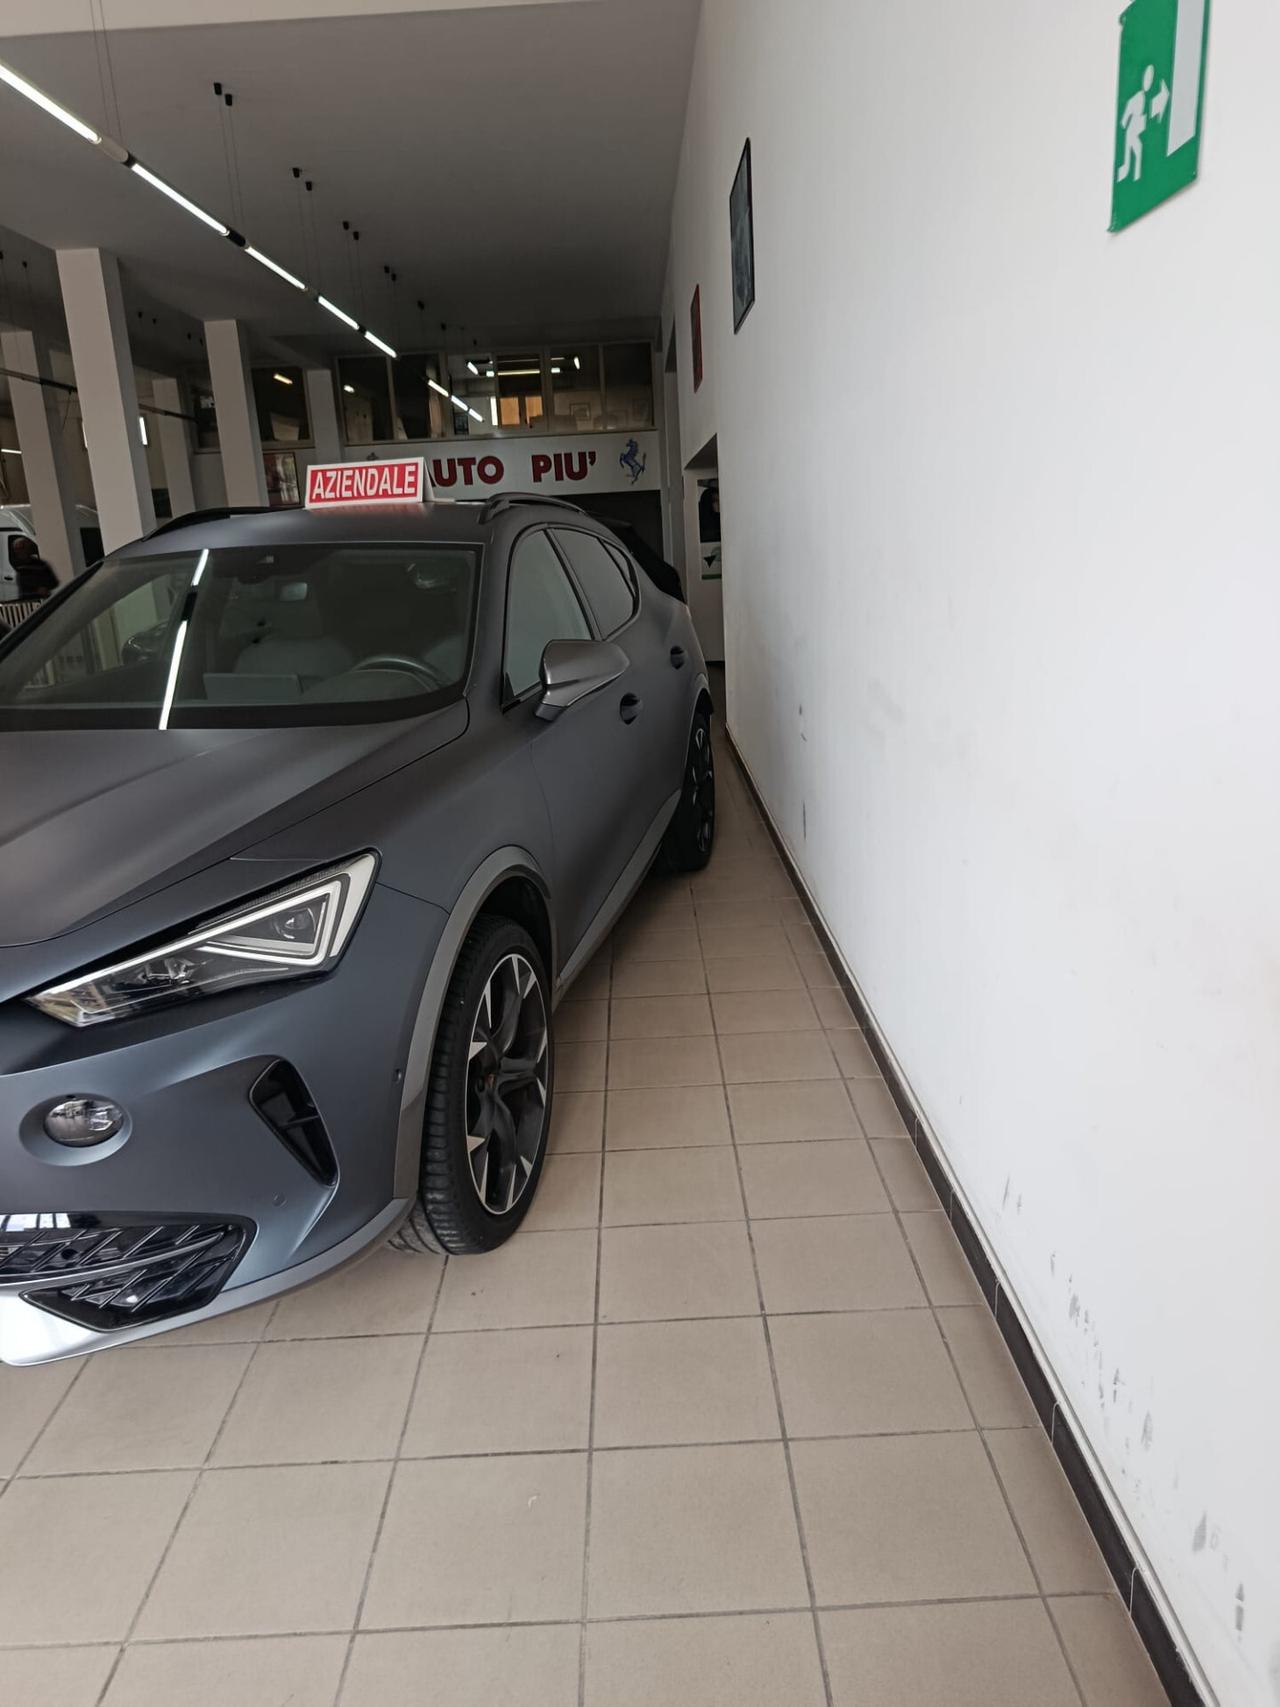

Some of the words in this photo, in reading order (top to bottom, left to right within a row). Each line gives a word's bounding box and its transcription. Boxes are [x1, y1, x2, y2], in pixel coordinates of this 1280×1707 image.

[311, 465, 416, 500] AZIENDALE
[429, 455, 505, 488] UTO
[531, 451, 597, 483] PIU'
